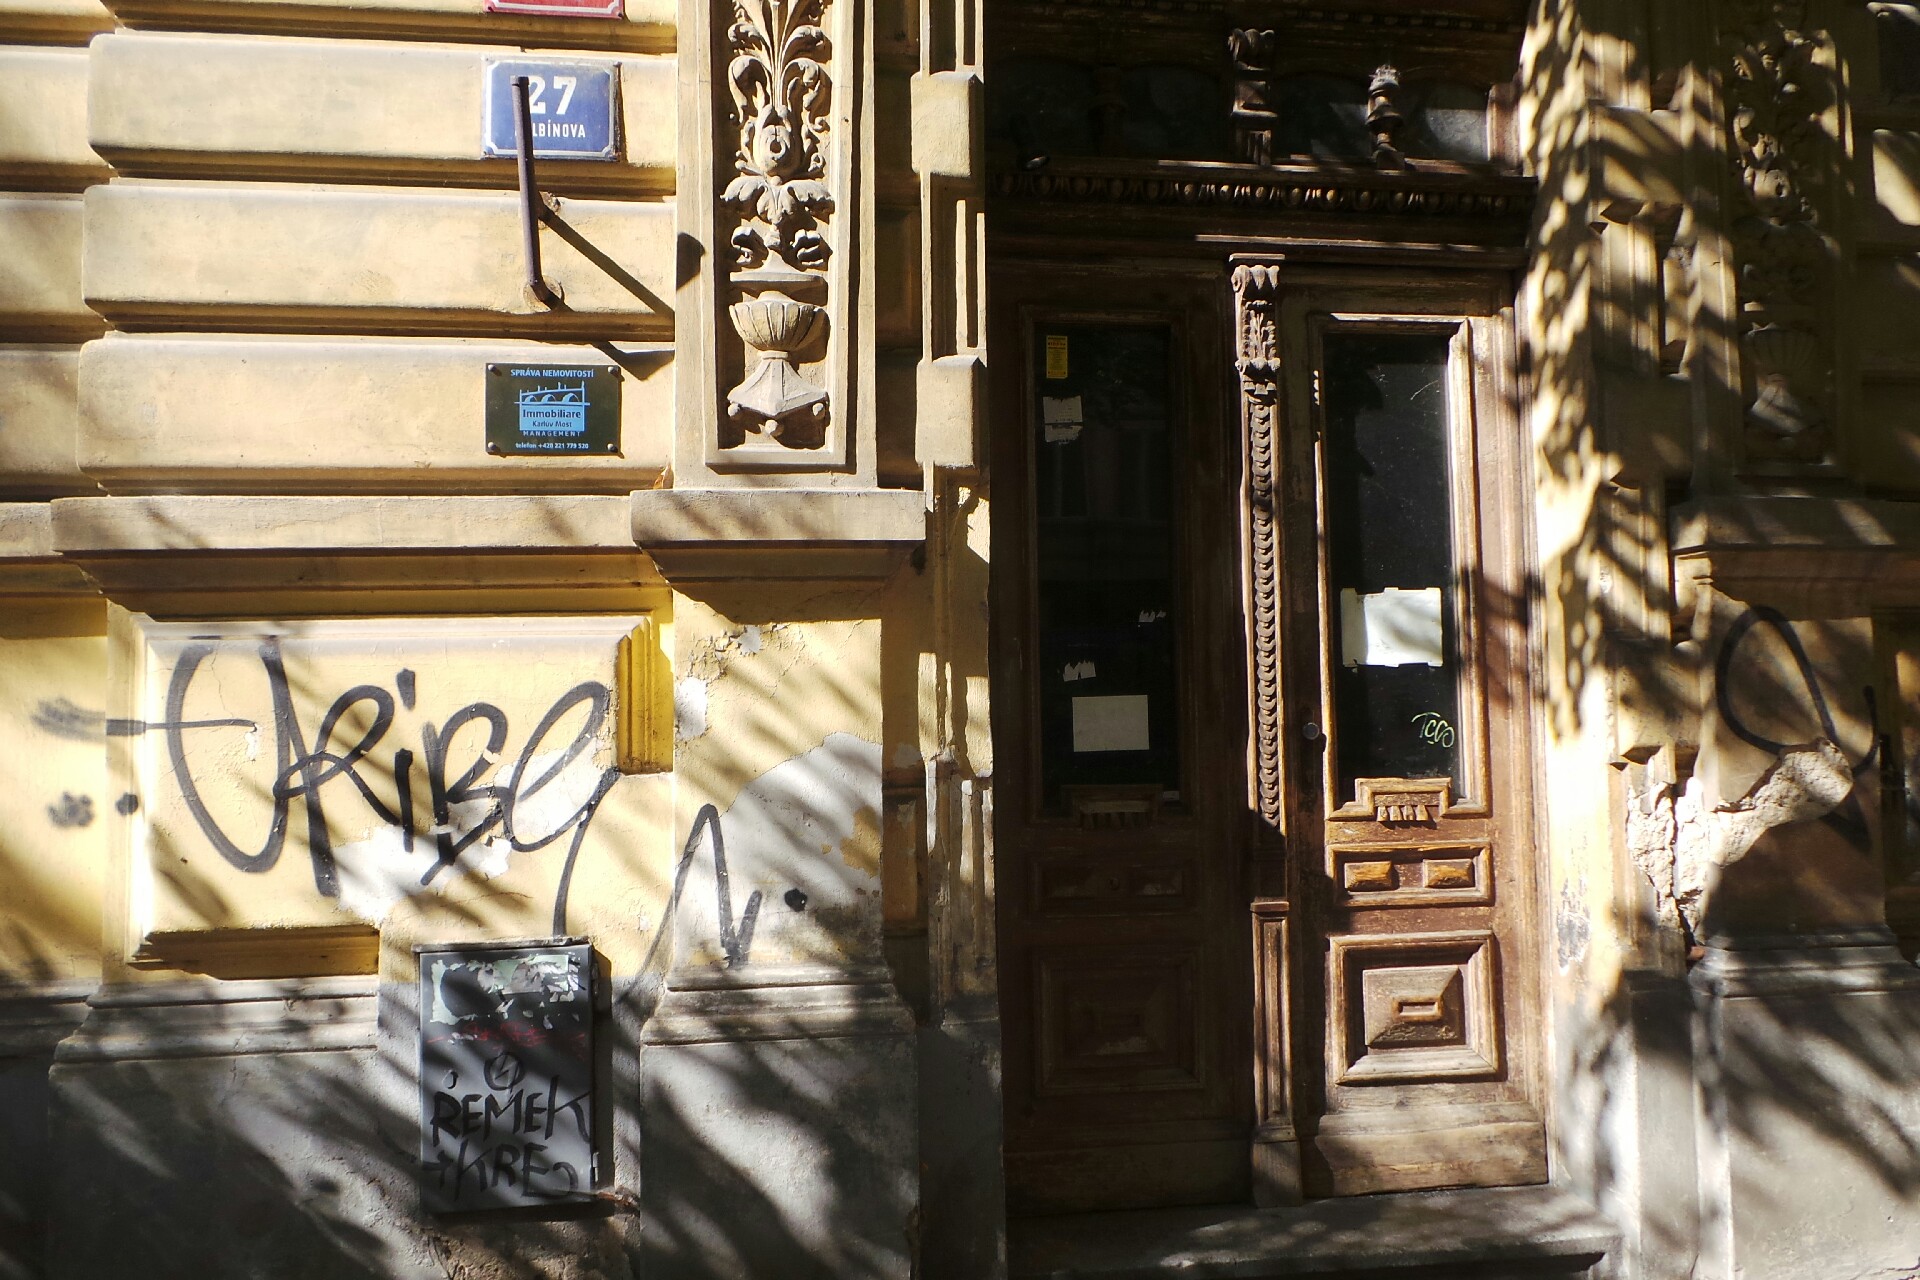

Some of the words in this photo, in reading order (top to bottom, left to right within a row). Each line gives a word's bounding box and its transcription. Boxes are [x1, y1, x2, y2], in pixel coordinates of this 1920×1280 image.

[526, 75, 577, 115] 27
[514, 118, 586, 138] LBÍNOVA
[510, 367, 541, 377] SPRÁVA
[542, 368, 594, 378] NEMOVITOSTÍ
[522, 409, 581, 419] Immobiliare
[555, 420, 572, 428] Most
